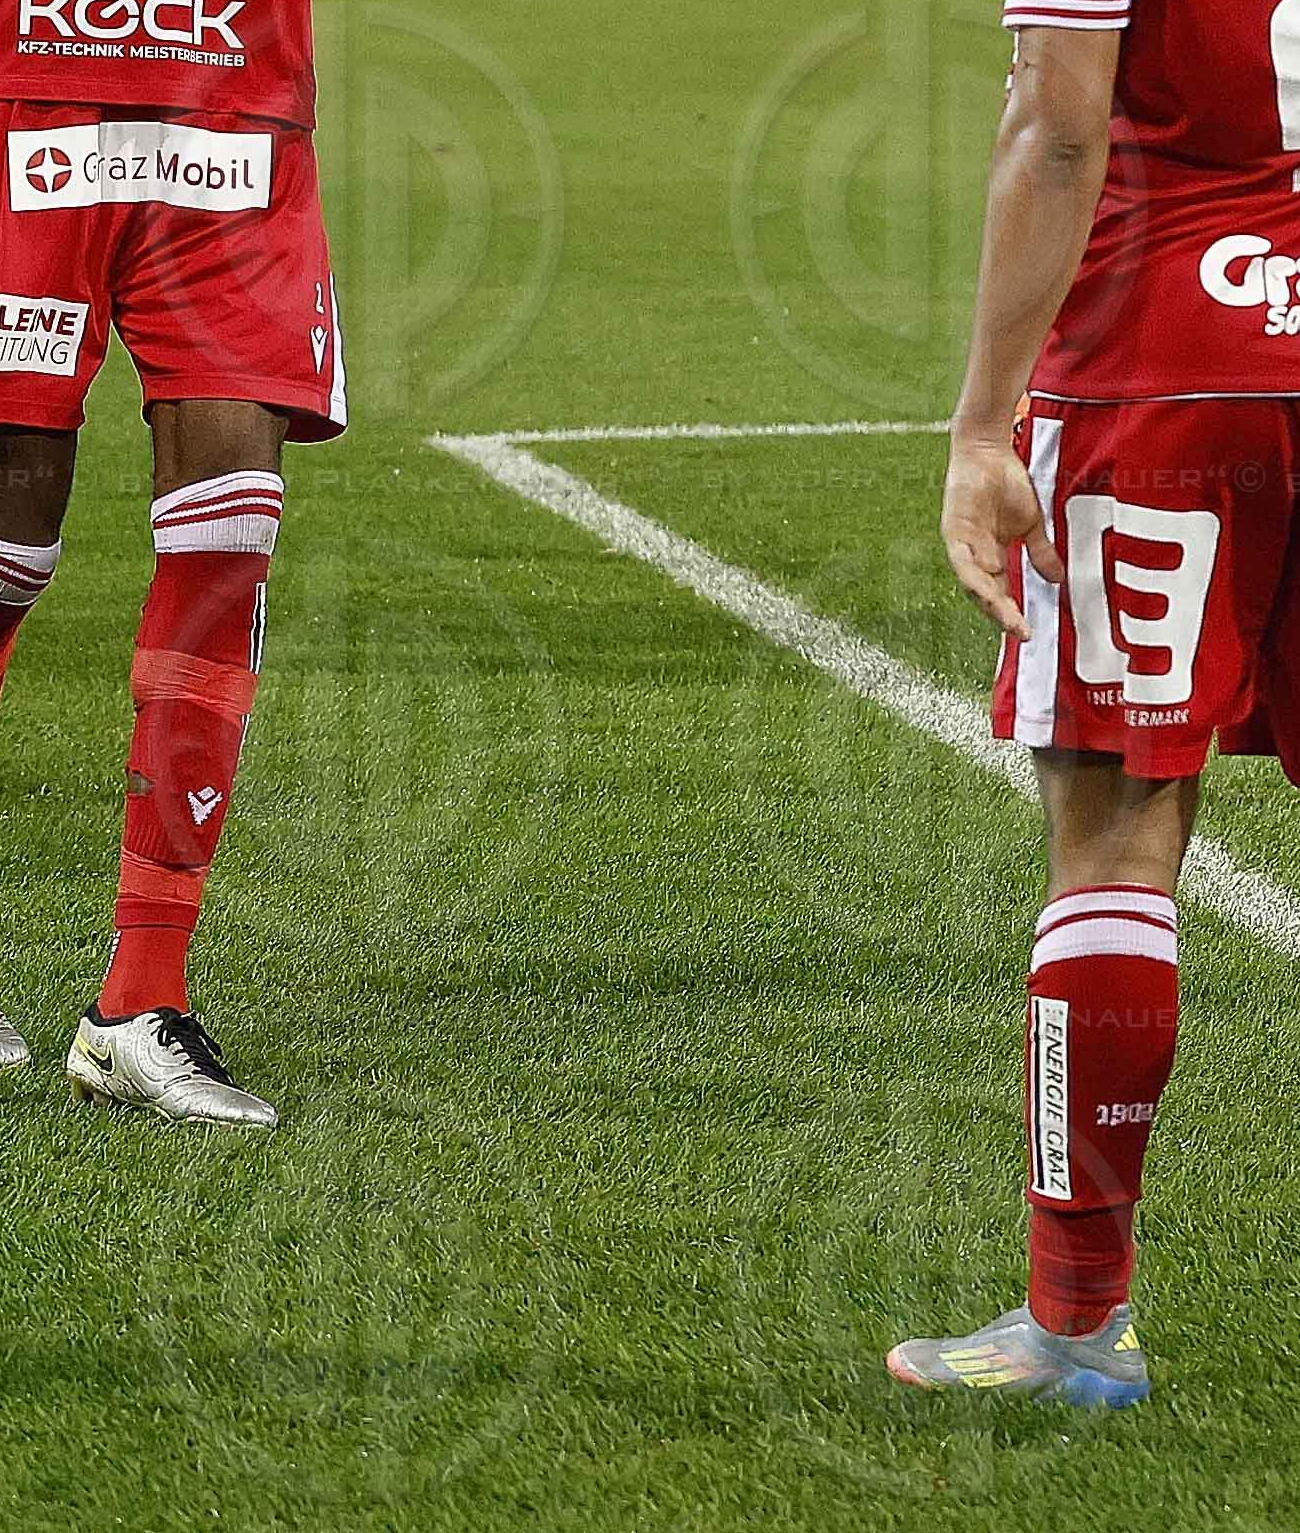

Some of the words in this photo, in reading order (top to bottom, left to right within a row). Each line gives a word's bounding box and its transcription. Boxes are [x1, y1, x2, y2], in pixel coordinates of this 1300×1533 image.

[17, 41, 125, 58] KFZ-TECHNIK
[130, 45, 245, 67] MEISTERBETRIEB
[1045, 1022, 1064, 1123] ENERGIE
[1046, 1128, 1067, 1191] GRAZ
